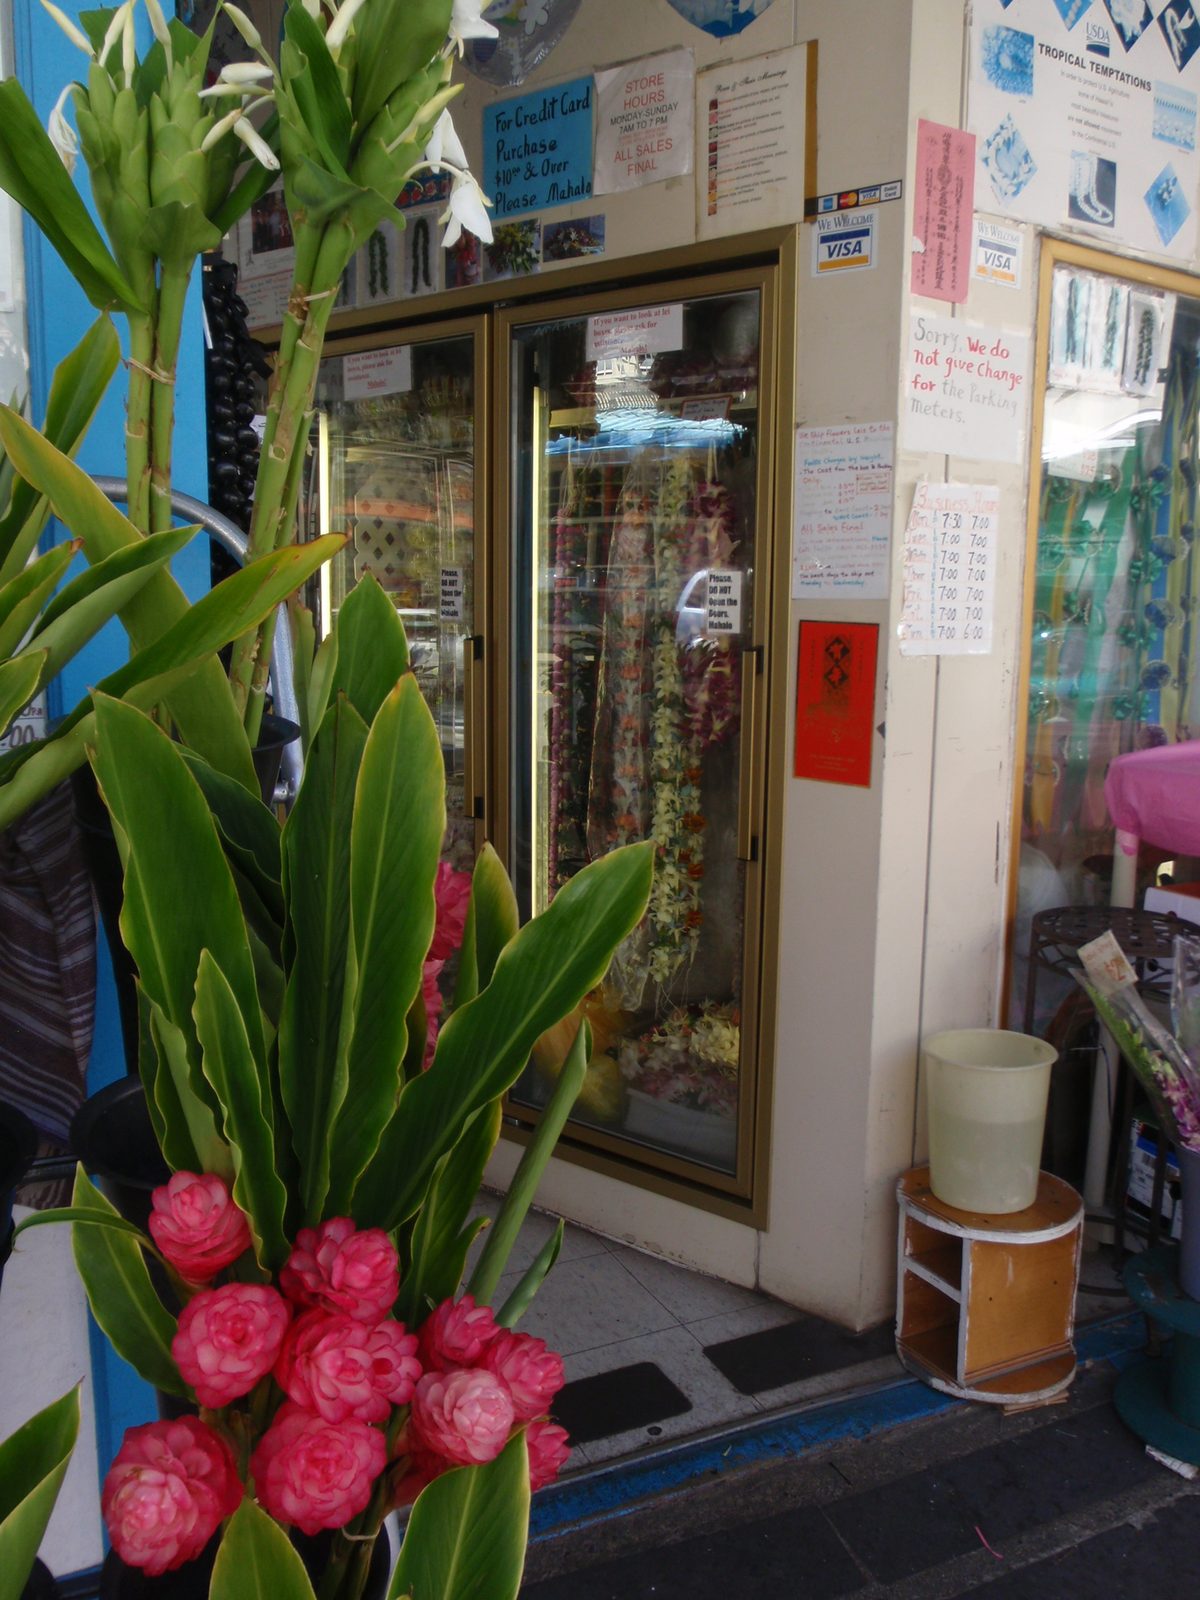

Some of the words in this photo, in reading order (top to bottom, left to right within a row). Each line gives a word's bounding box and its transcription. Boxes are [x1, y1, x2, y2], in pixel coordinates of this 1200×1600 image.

[1086, 22, 1110, 43] USDA
[1038, 43, 1087, 69] TROPICAL
[1089, 61, 1152, 92] TEMPTATIONS
[625, 72, 665, 94] STORE
[495, 111, 513, 133] For
[515, 97, 558, 128] Credit
[561, 86, 590, 116] Card
[624, 90, 665, 110] HOURS
[610, 102, 679, 126] MONDAY-SUNDAY
[620, 123, 635, 134] 7AM
[636, 120, 647, 130] TO
[649, 118, 654, 128] 7
[655, 115, 668, 126] PM
[496, 134, 557, 164] Purchase
[614, 147, 633, 163] ALL
[636, 138, 673, 158] SALES
[523, 162, 538, 180] &
[541, 158, 569, 177] Over
[627, 158, 658, 177] FINAL
[546, 176, 592, 203] Mahalo
[827, 240, 862, 259] VISA
[984, 250, 1011, 271] VISA
[613, 314, 629, 323] want
[639, 310, 652, 318] look
[647, 321, 657, 329] for
[967, 337, 986, 355] We
[990, 338, 1009, 359] do
[914, 348, 940, 366] not
[944, 357, 974, 378] give
[912, 374, 936, 391] for
[942, 380, 965, 400] the
[942, 512, 961, 529] 7:30
[971, 514, 990, 530] 7:00
[940, 531, 960, 546] 7:00
[970, 533, 988, 548] 7:00
[940, 550, 960, 565] 7:00
[968, 551, 987, 565] 7:00
[939, 567, 959, 581] 7:00
[968, 567, 986, 582] 7:00
[709, 586, 718, 594] DO
[719, 586, 731, 594] NOT
[937, 585, 957, 601] 7:00
[967, 586, 984, 602] 7:00
[709, 597, 726, 606] Open
[727, 598, 737, 606] the
[939, 606, 957, 621] 7:00
[965, 606, 983, 621] 7:00
[709, 621, 733, 629] Mahalo
[937, 625, 956, 640] 7:00
[963, 623, 983, 640] 6:00
